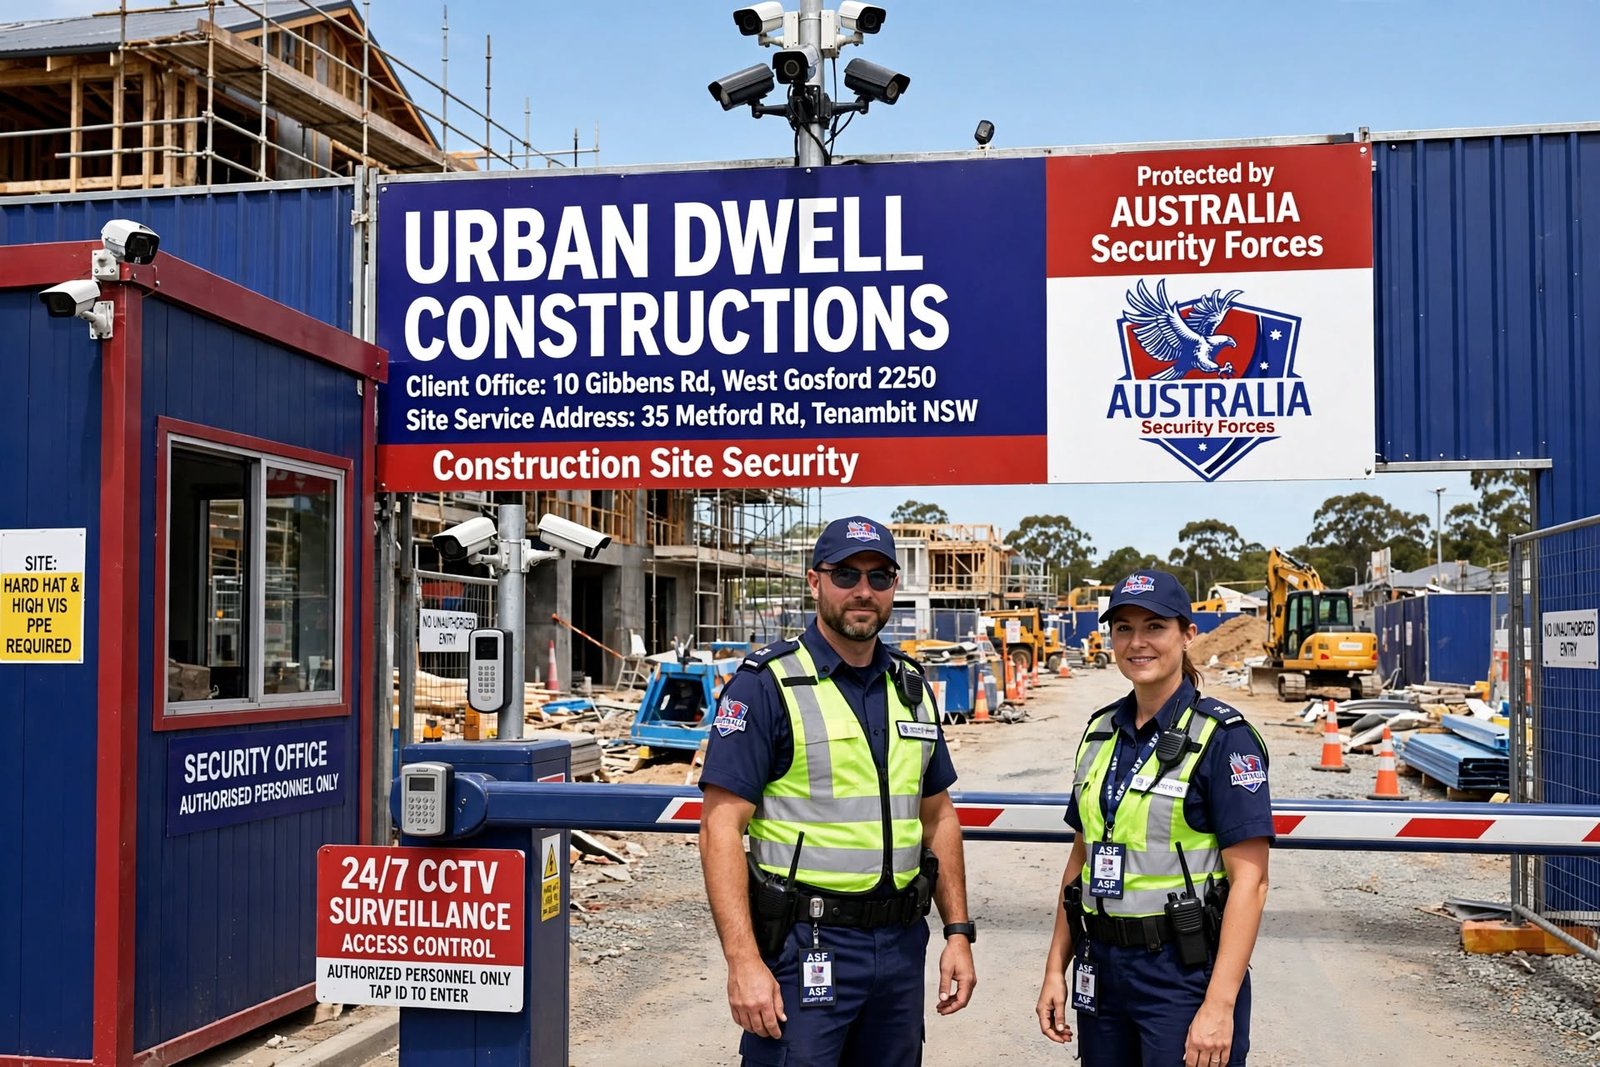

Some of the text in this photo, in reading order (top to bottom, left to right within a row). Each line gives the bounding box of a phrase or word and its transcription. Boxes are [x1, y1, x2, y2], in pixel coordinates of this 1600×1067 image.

[1138, 162, 1274, 186] Protected by
[1111, 192, 1300, 227] AUSTRALIA
[406, 196, 923, 284] URBAN DWELL
[1092, 231, 1323, 266] Security Forces
[405, 284, 949, 361] CONSTRUCTIONS
[407, 366, 936, 397] Client Office: 10 Gibbens Rd, West Gosford 2250
[1107, 382, 1312, 418] AUSTRALIA
[407, 399, 978, 430] Site Service Address: 35 Metford Rd, Tenambit NSW
[1142, 420, 1274, 437] Security Forces
[433, 445, 859, 483] Construction Site Security
[25, 556, 56, 571] SITE:
[5, 578, 79, 592] HARD HAT &
[48, 598, 67, 613] VIS
[27, 618, 51, 633] PPE
[422, 615, 432, 628] NO
[1544, 623, 1552, 637] NO
[7, 639, 71, 654] REQUIRED
[439, 633, 456, 645] ENTRY
[1560, 642, 1577, 656] ENTRY
[185, 741, 327, 783] SECURITY OFFICE
[180, 773, 338, 815] AUTHORISED PERSONNEL ONLY
[1098, 846, 1119, 855] ASF
[342, 856, 498, 894] 24/7 CCTV
[1097, 880, 1116, 889] ASF
[330, 897, 510, 930] SURVEILLANCE
[342, 934, 495, 958] ACCESS CONTROL
[806, 952, 828, 962] ASF
[328, 965, 510, 985] AUTHORIZED PERSONNEL ONLY
[1078, 963, 1093, 974] ASF
[369, 985, 468, 1002] TAP ID TO ENTER
[808, 987, 827, 996] ASF
[1078, 994, 1092, 1005] ASF
